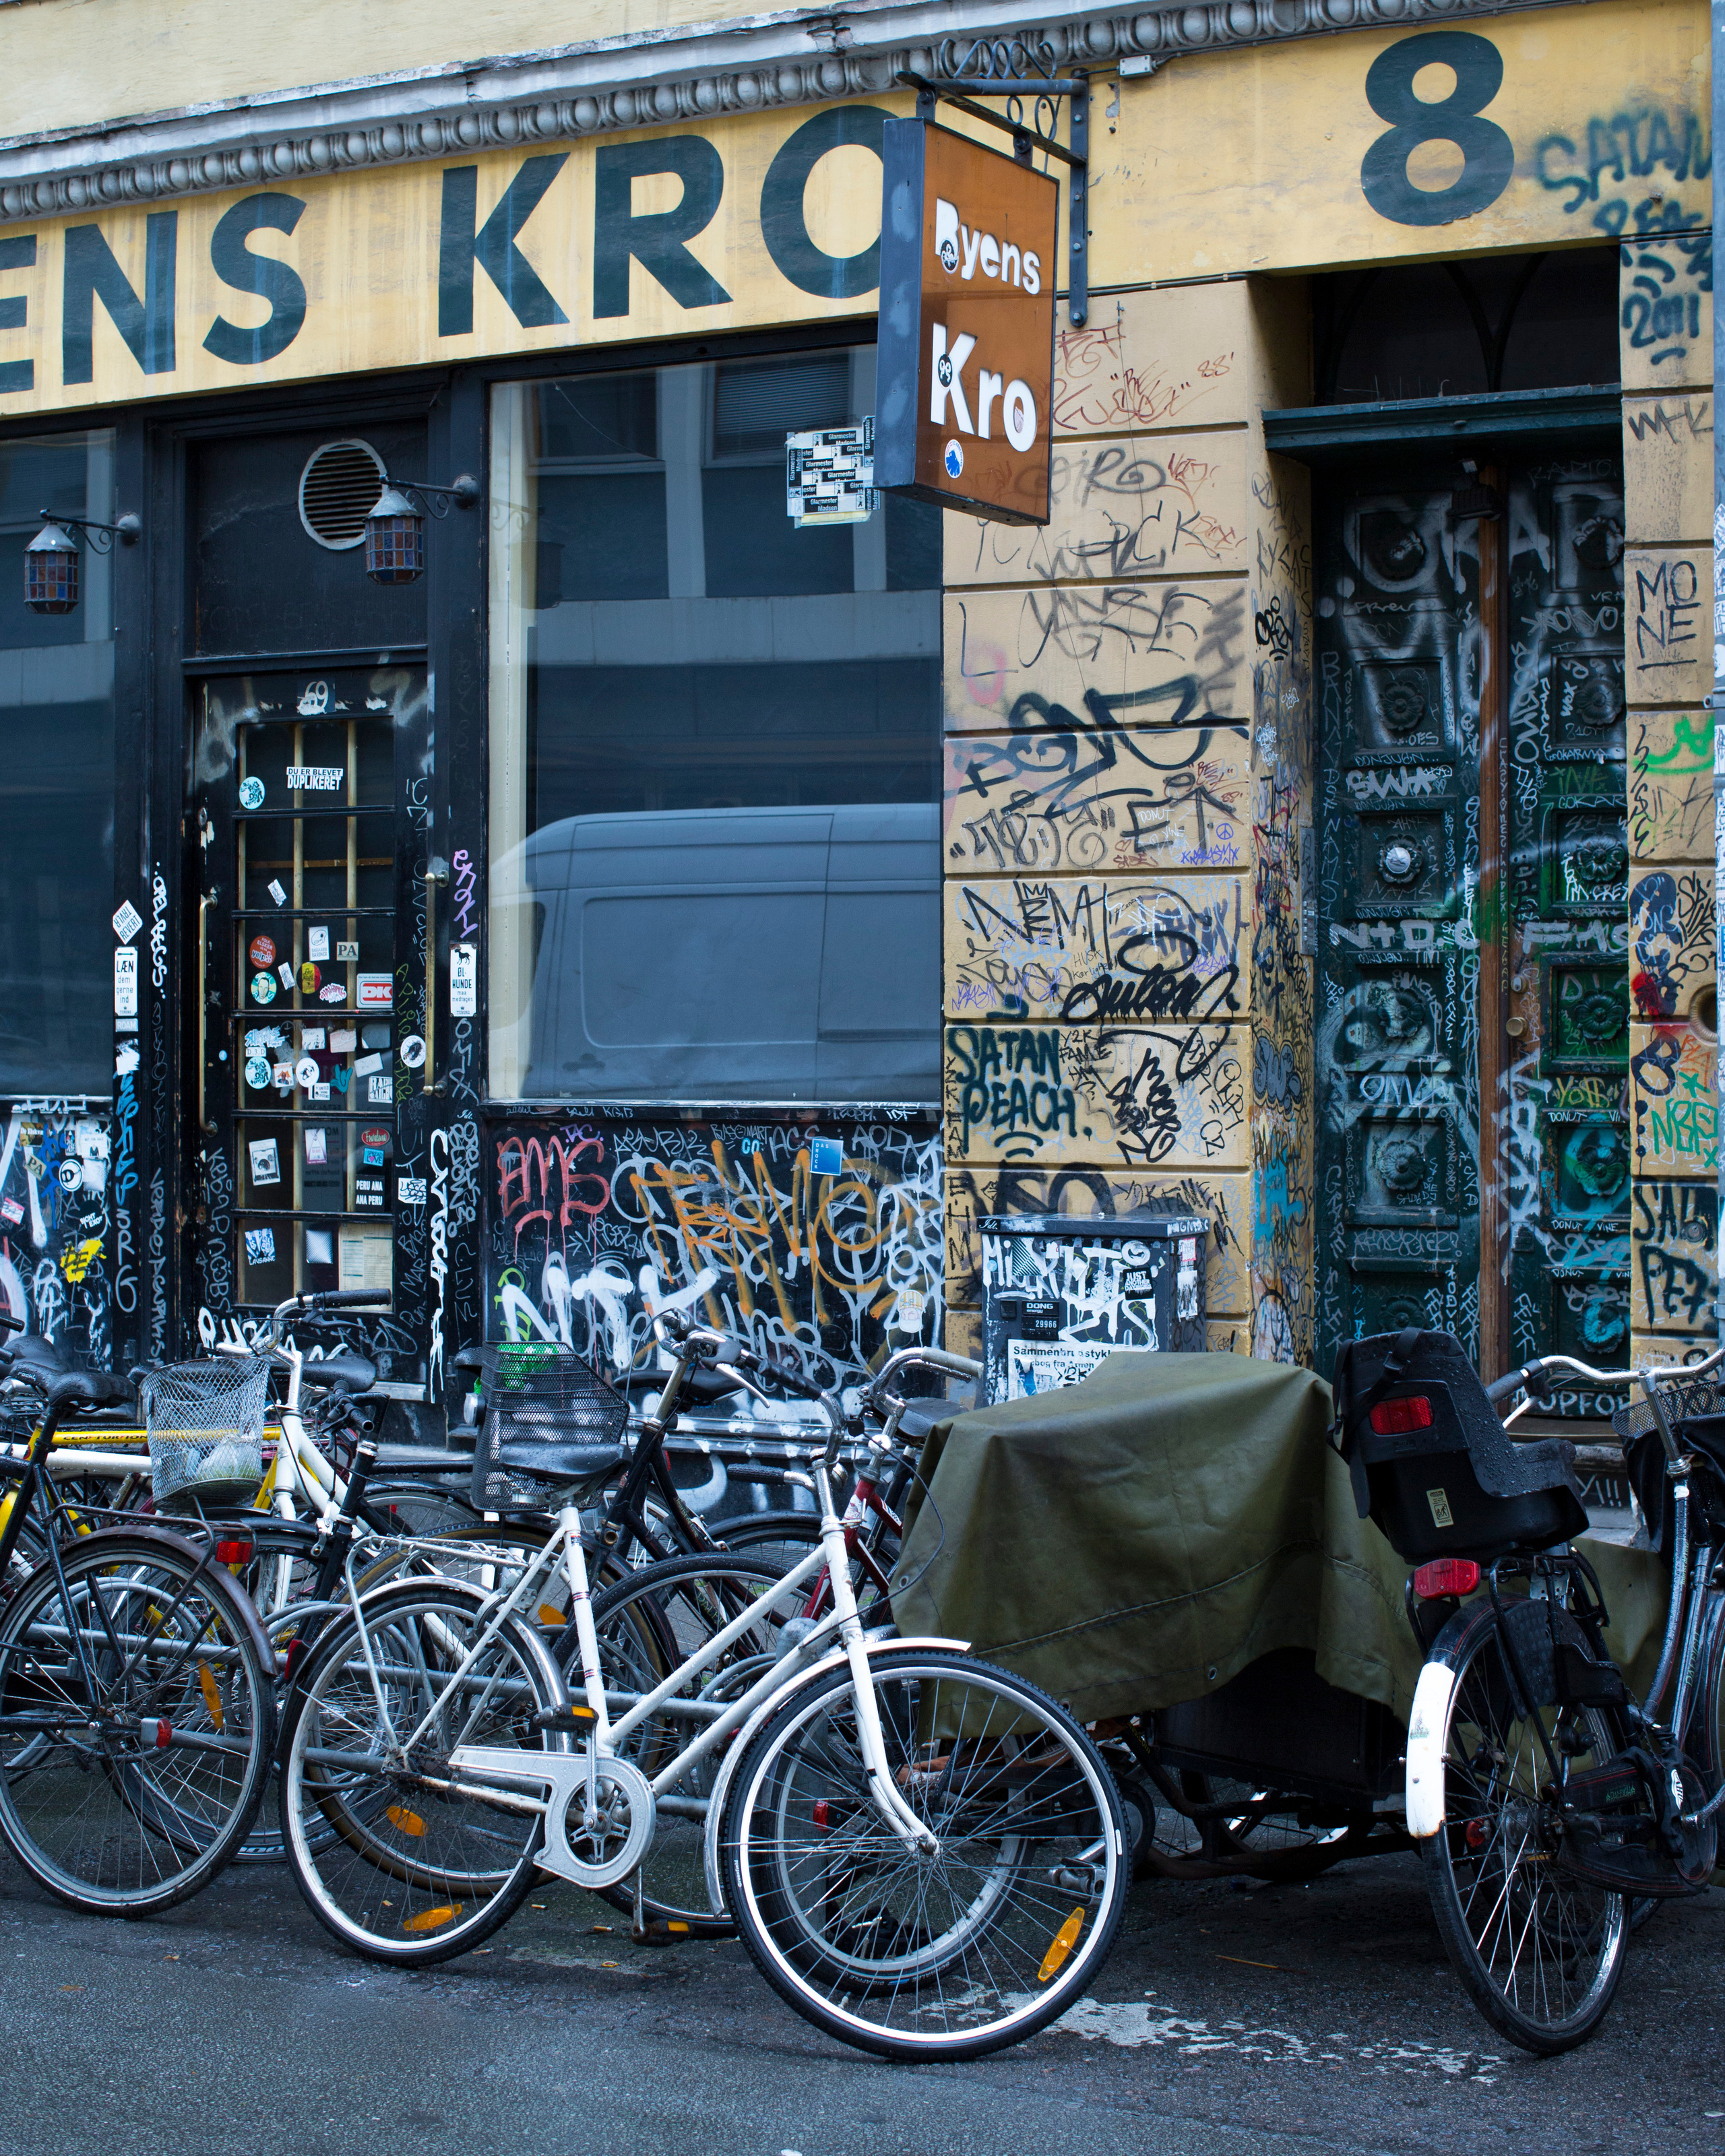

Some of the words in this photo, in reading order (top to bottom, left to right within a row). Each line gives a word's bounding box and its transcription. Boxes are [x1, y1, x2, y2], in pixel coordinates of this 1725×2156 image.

[1361, 30, 1514, 227] 8
[438, 105, 885, 337] KRO
[935, 197, 1041, 295] Byens
[931, 322, 1037, 452] Kro
[287, 776, 342, 790] DUPLIKERET
[1137, 806, 1174, 824] DONUT
[119, 915, 140, 941] REVERT
[252, 949, 265, 961] yelp
[338, 945, 357, 956] PA
[117, 960, 133, 973] LÆN
[452, 979, 472, 989] HUNDE
[116, 986, 133, 995] gerne
[947, 1027, 1062, 1087] SATAN
[1548, 1112, 1588, 1122] DONUT
[28, 1158, 43, 1176] PA
[356, 1180, 371, 1191] PERU
[371, 1181, 383, 1191] ANA
[356, 1195, 368, 1205] ANA
[369, 1195, 383, 1205] PERU
[1551, 1220, 1583, 1230] DONUT
[1597, 1222, 1619, 1232] VINE
[1126, 1271, 1147, 1281] JUST
[1551, 1268, 1584, 1279] DONUT
[1035, 1320, 1057, 1328] 29966
